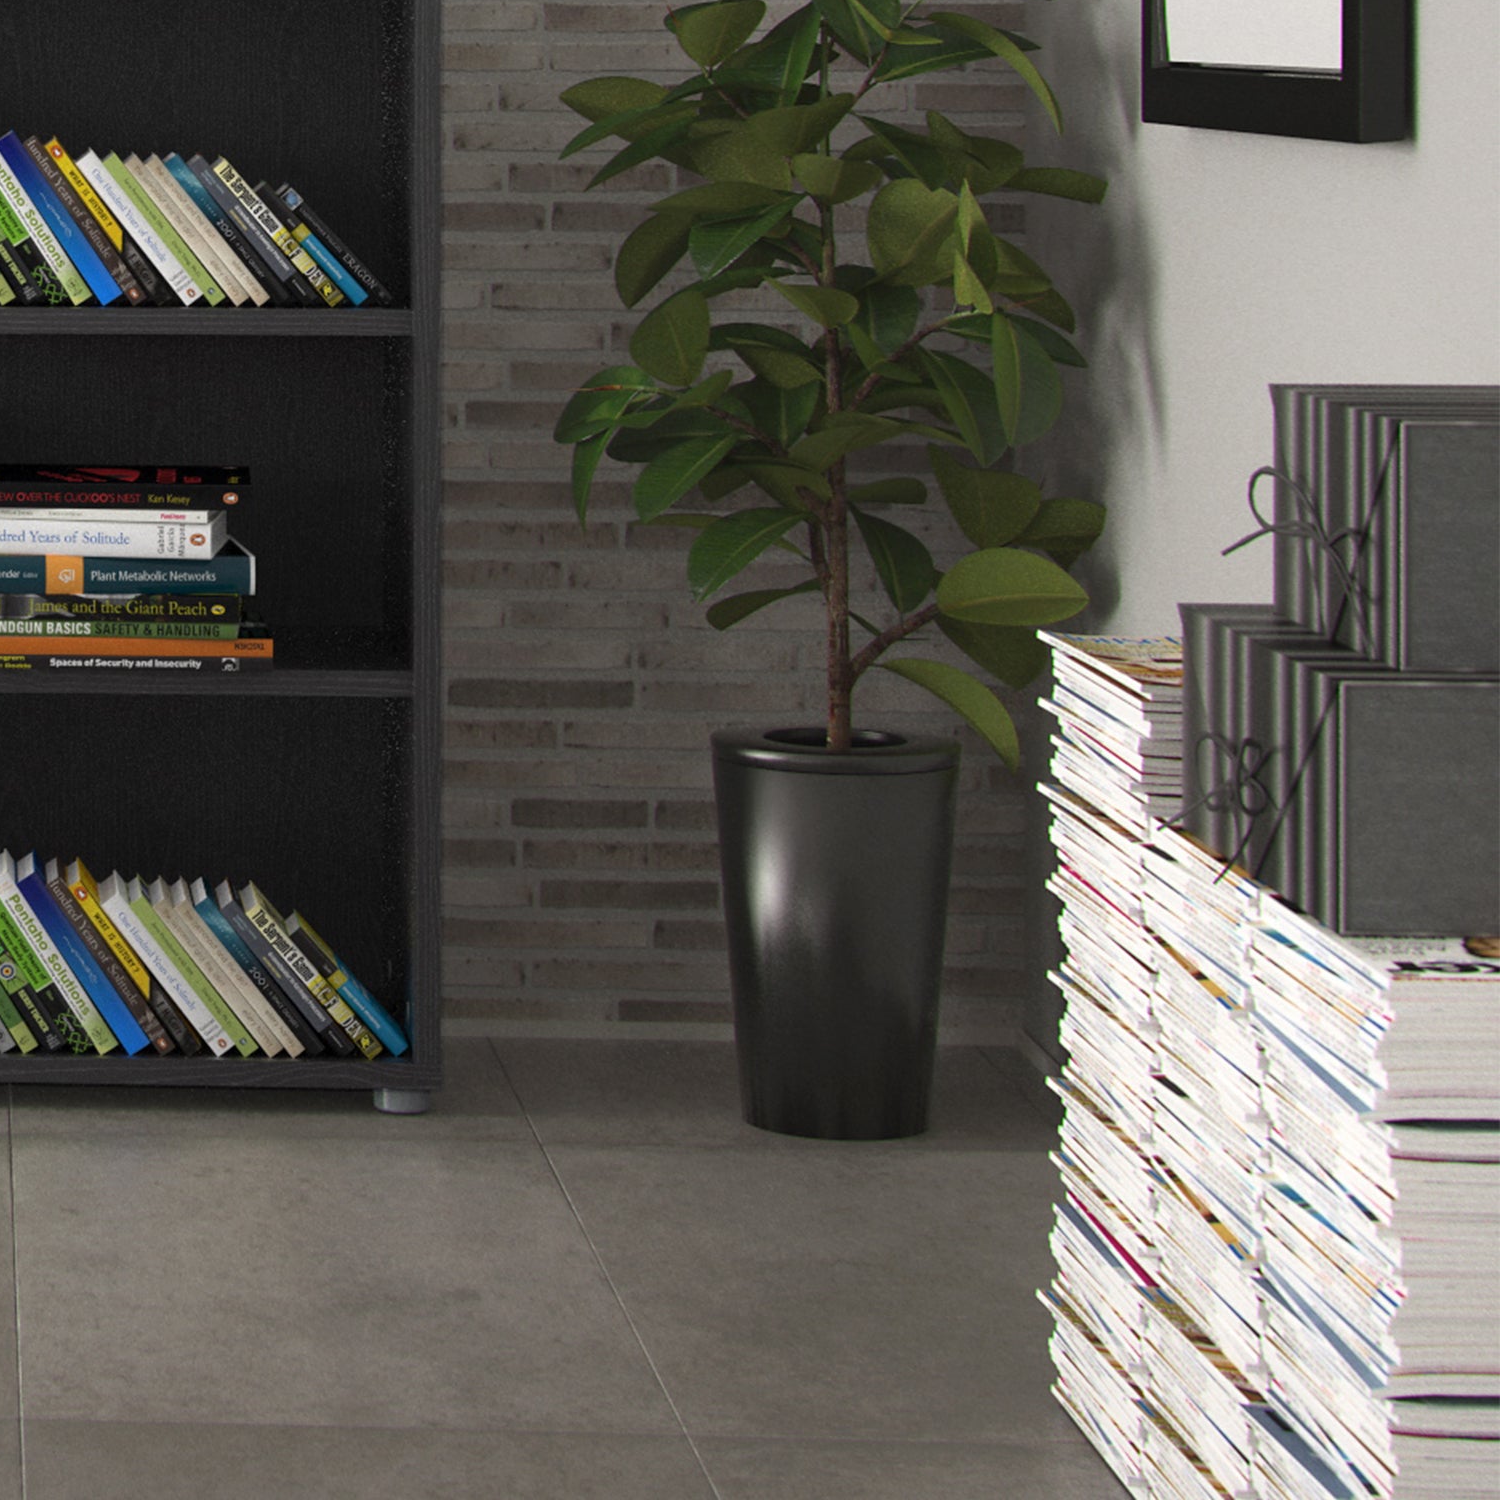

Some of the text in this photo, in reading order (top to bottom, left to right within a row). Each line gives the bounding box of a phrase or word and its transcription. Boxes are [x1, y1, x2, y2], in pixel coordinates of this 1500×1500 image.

[218, 164, 281, 234] The Serpent's Game
[52, 177, 77, 206] Years
[70, 203, 86, 218] of
[80, 217, 114, 259] Solitude
[215, 217, 237, 242] 2001
[23, 208, 67, 269] Solutions
[341, 251, 377, 290] ERAGON
[16, 492, 44, 502] OVER
[45, 492, 61, 502] THE
[117, 493, 142, 503] NEST
[148, 495, 165, 503] Ken
[29, 531, 61, 543] Years
[63, 530, 78, 543] of
[82, 531, 130, 545] Solitude
[156, 525, 165, 554] Gabriel
[90, 570, 217, 582] Plant Metabolic Networks
[28, 599, 68, 615] James
[72, 600, 97, 614] and
[101, 600, 122, 614] the
[126, 601, 164, 615] Giant
[168, 601, 208, 616] Peach
[46, 622, 91, 634] BASICS
[95, 623, 140, 635] SAFETY
[143, 624, 152, 636] &
[156, 624, 220, 637] HANDLING
[49, 658, 202, 669] Spaces of Security and Insecurity
[8, 892, 93, 1016] Pentaho Solutions
[92, 911, 110, 932] WHAT
[113, 940, 135, 968] HISTORY
[251, 908, 317, 982] The Serpent's Game
[76, 919, 102, 951] Years
[95, 947, 111, 964] of
[105, 962, 140, 1007] Solitude
[247, 965, 270, 990] 2001
